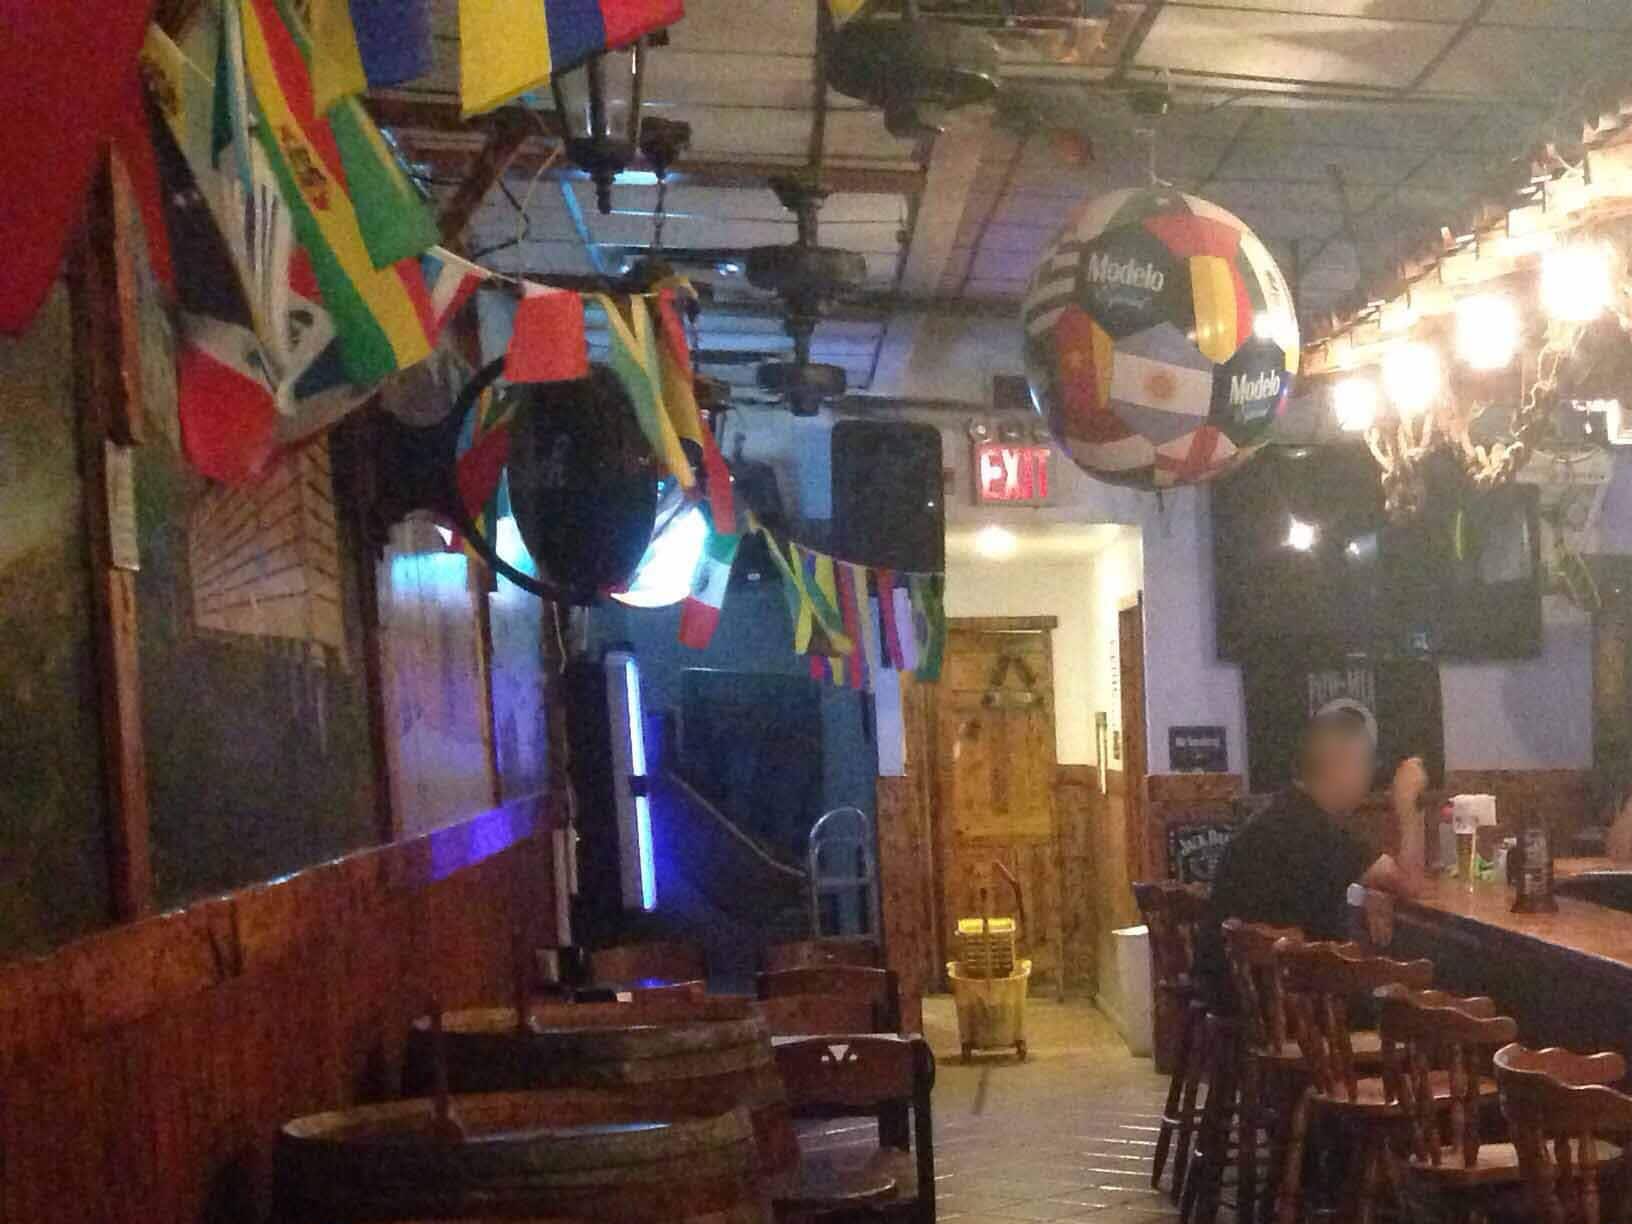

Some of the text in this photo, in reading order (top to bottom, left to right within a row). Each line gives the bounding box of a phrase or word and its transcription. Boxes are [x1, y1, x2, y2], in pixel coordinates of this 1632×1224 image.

[1087, 253, 1165, 292] Modelo
[1230, 369, 1280, 405] Modelo
[980, 448, 1050, 499] EXIT
